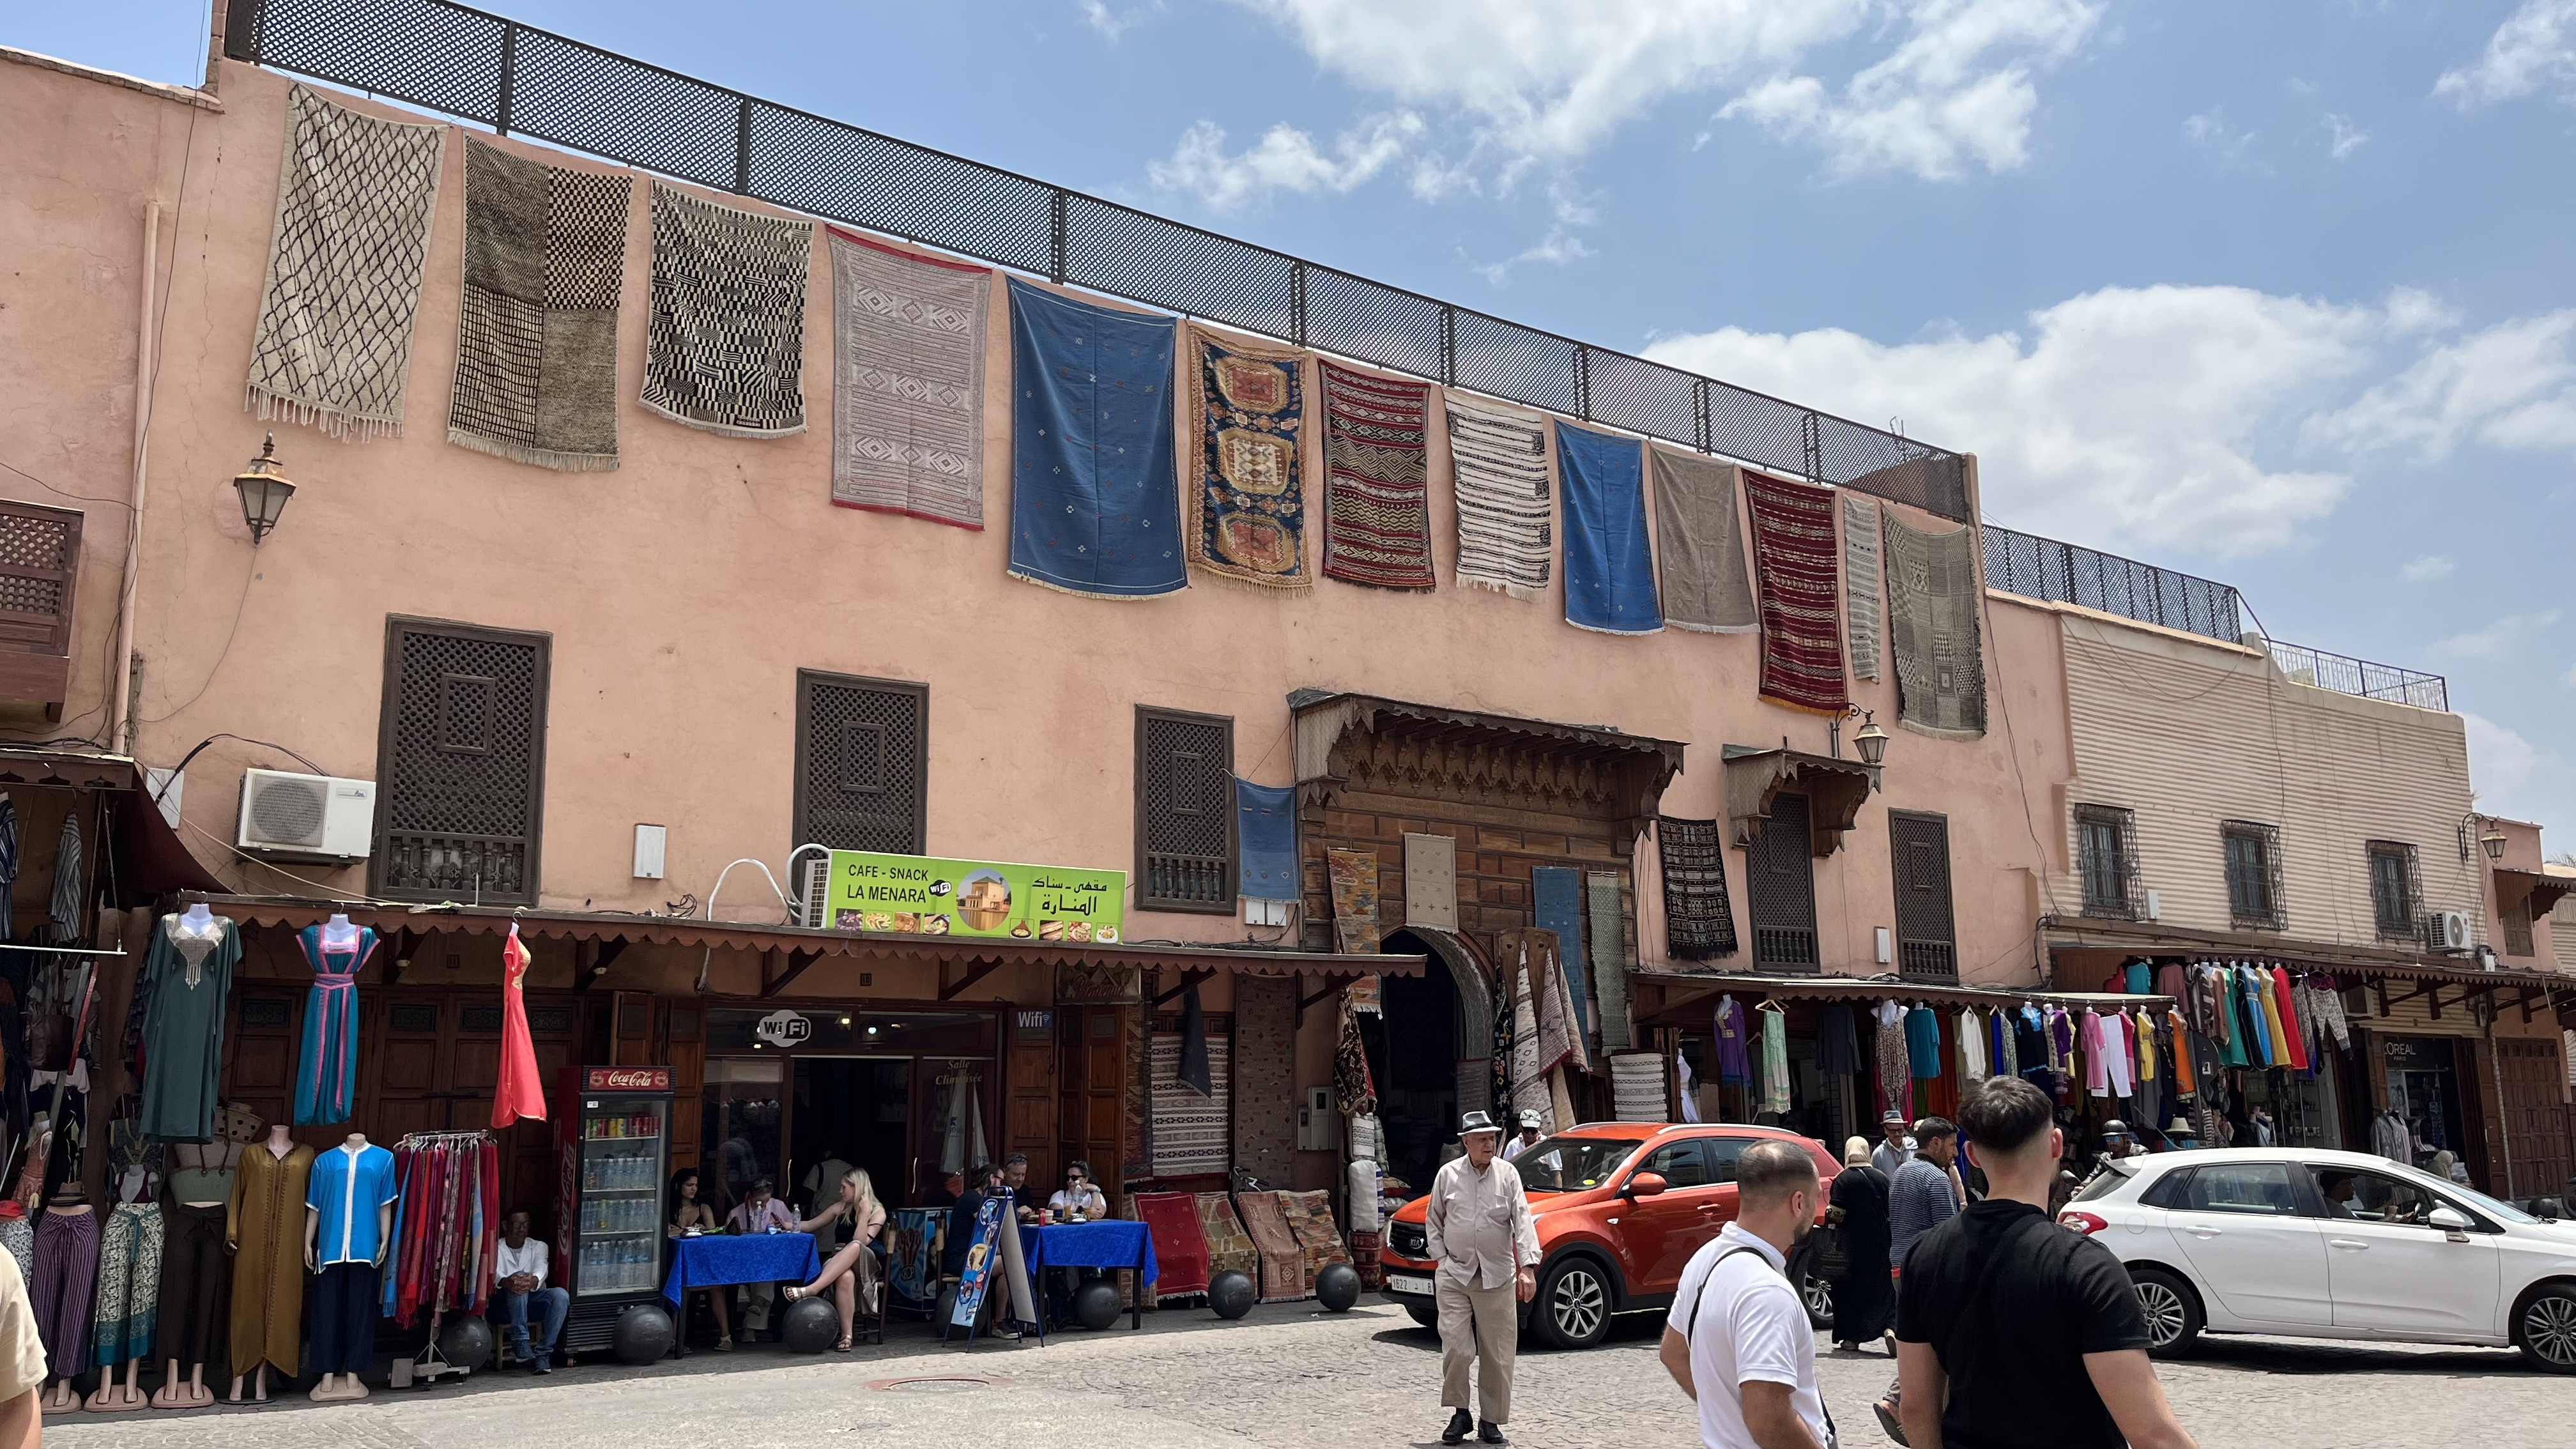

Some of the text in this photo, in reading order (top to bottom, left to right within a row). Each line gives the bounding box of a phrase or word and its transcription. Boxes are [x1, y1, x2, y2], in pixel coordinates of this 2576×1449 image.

[848, 864, 878, 878] CAFE
[889, 867, 928, 881] SNACK
[1032, 875, 1063, 889] سناك
[1074, 879, 1107, 893] مقهى
[847, 884, 926, 903] LA MENARA
[1042, 894, 1097, 916] المنارة
[1018, 1011, 1043, 1028] Wifi
[947, 1059, 970, 1070] Salle
[935, 1073, 982, 1085] Climatisée
[1393, 1278, 1407, 1290] 1622
[1427, 1283, 1432, 1292] 8
